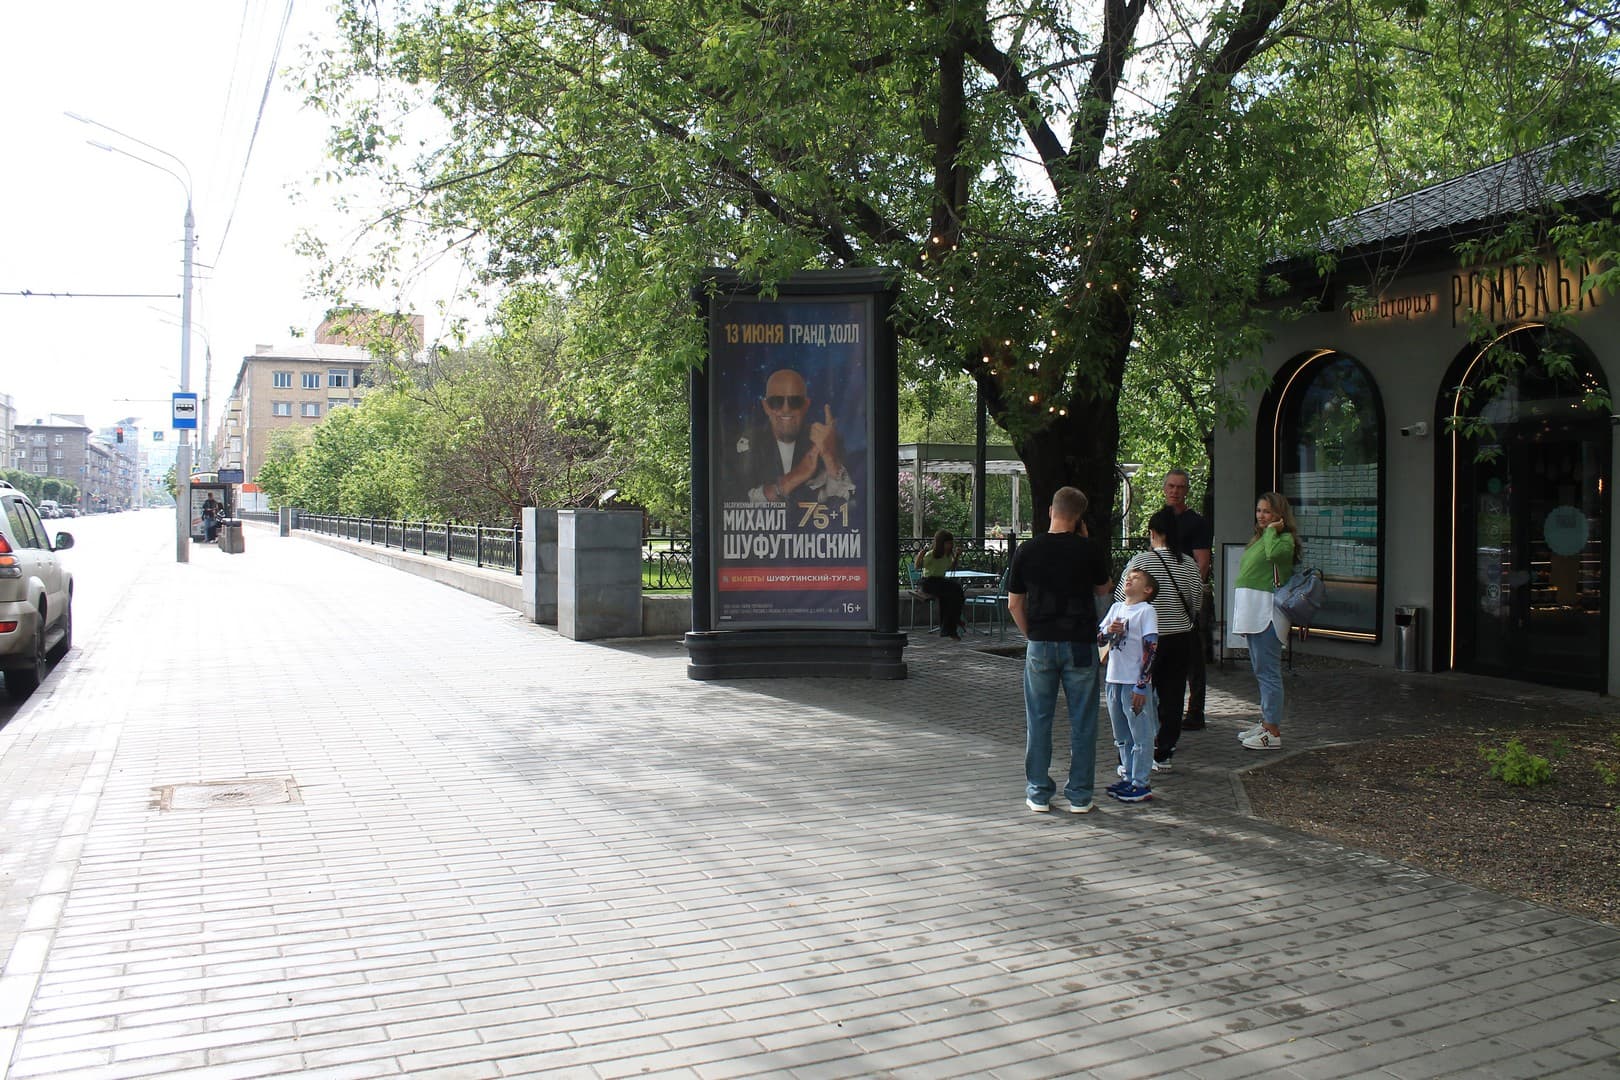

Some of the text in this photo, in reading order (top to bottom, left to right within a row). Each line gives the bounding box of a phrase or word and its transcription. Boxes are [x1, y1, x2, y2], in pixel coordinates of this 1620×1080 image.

[725, 323, 860, 346] 13 ИЮНЯ ГРАНД ХОЛЛ
[723, 509, 787, 531] МИХАИЛ
[798, 502, 849, 529] 75+1
[723, 529, 861, 559] ШУФУТИНСКИЙ
[731, 574, 861, 583] БИЛЕТЫ ШУФУТИНСКИЙ-ТУР.РФ
[842, 603, 861, 614] 16+
